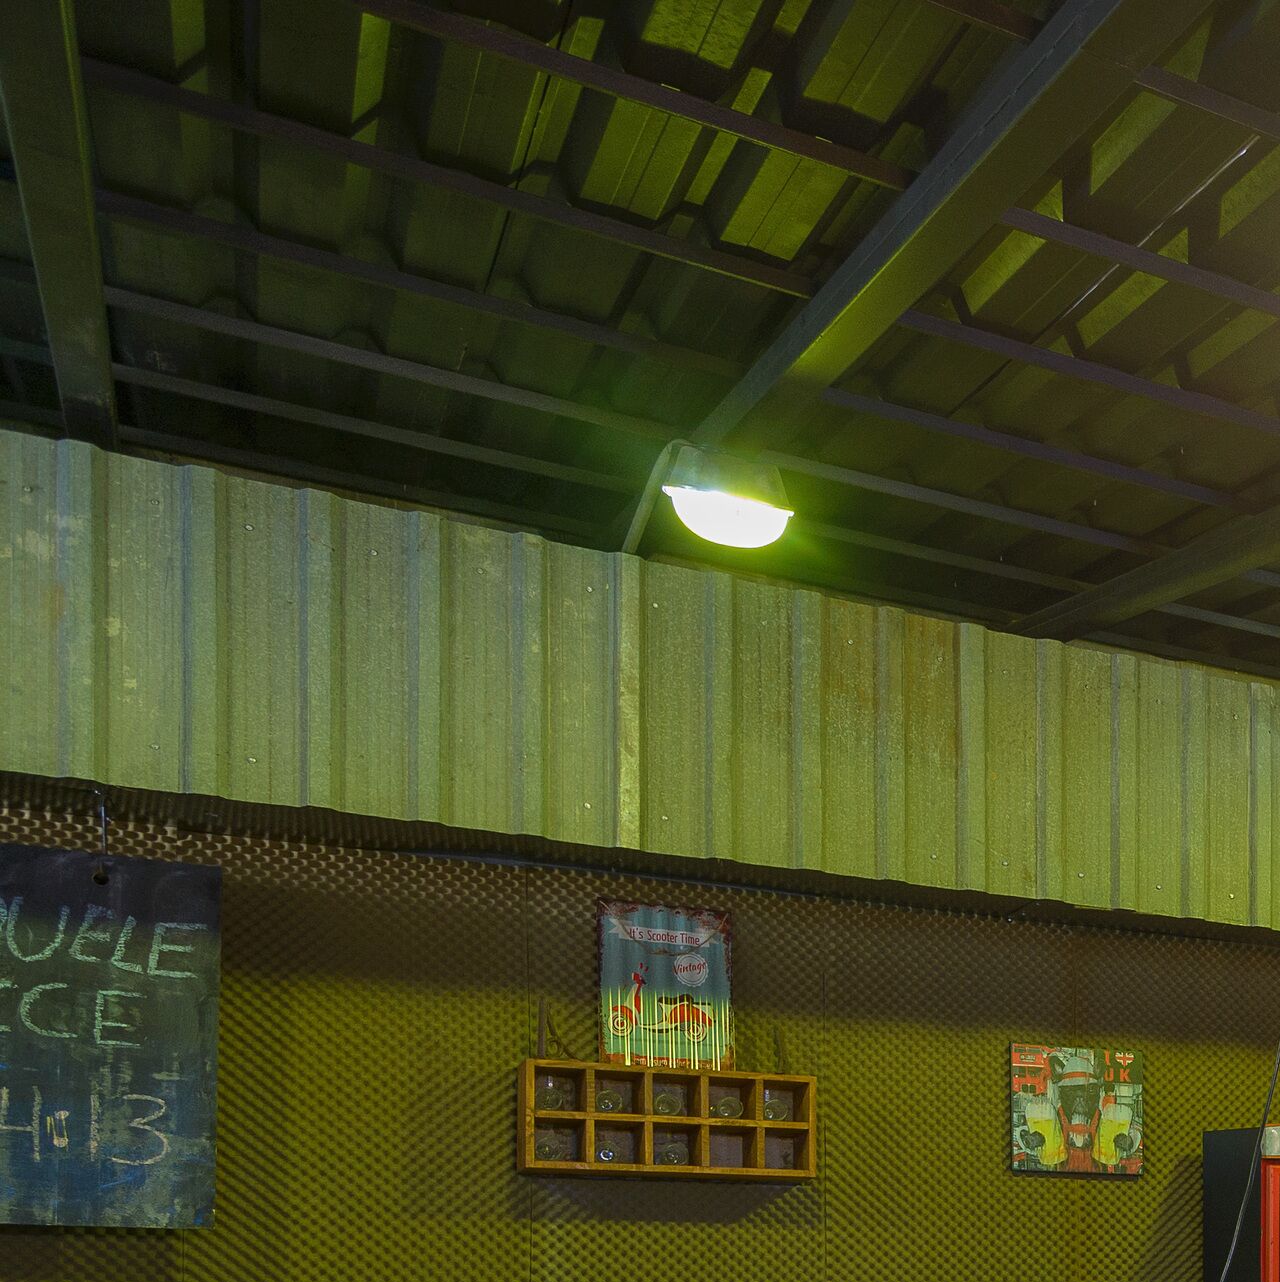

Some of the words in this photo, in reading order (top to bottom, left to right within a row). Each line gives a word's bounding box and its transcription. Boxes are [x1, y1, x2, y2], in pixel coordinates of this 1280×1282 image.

[0, 896, 208, 979] UELE
[629, 927, 644, 939] It's
[647, 929, 678, 943] Scooter
[681, 932, 701, 945] Time
[672, 961, 707, 976] Vintage
